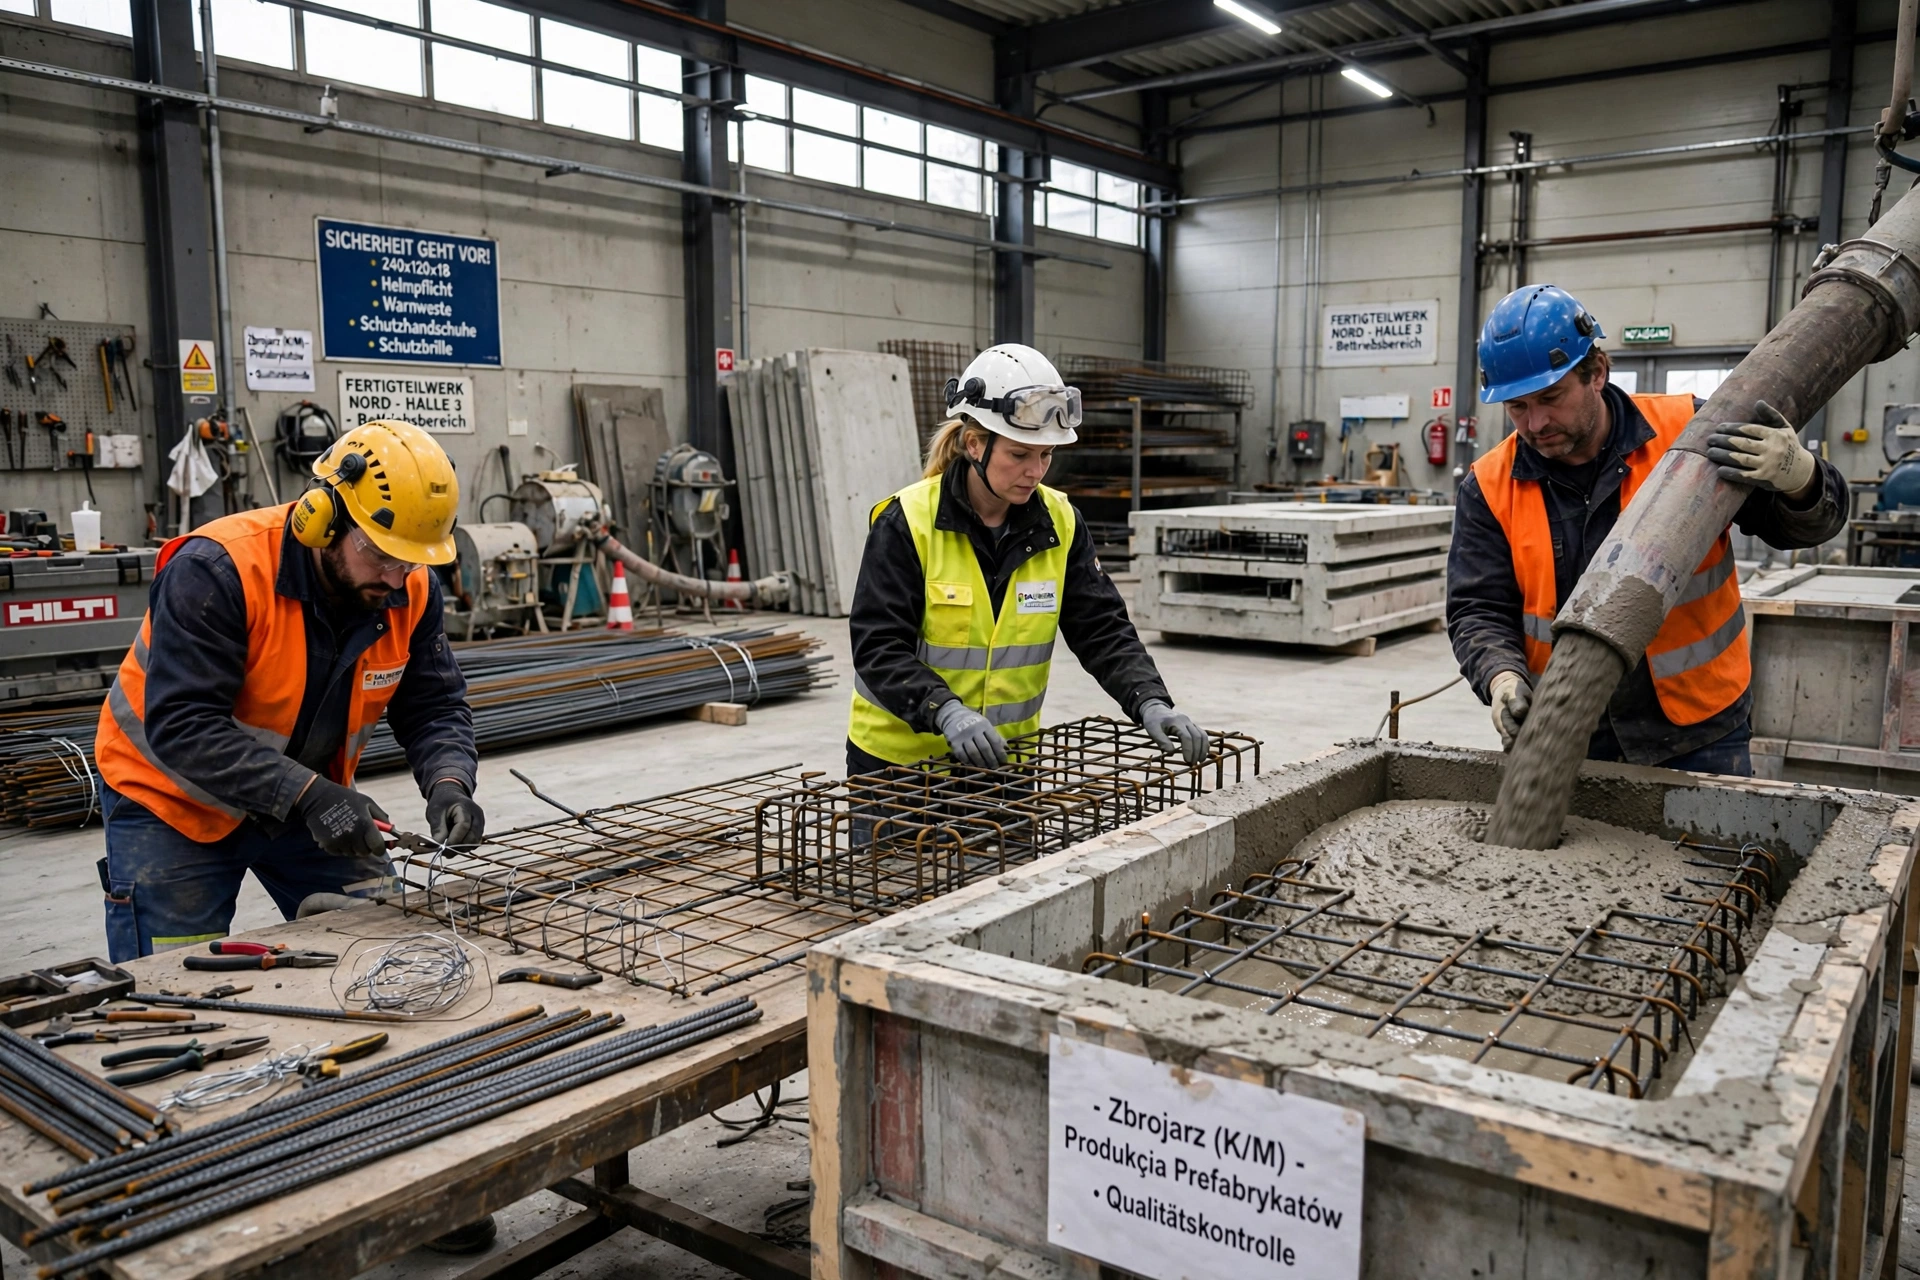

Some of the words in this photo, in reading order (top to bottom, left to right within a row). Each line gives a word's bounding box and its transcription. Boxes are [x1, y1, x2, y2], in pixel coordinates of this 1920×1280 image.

[325, 229, 414, 256] SICHERHEIT
[417, 240, 456, 259] GEHT
[458, 245, 491, 265] VOR!
[381, 257, 451, 278] 240x120x18
[381, 276, 453, 298] Helmpflicht
[382, 296, 452, 317] Warnweste
[360, 315, 477, 338] Schutzhandschuhe
[1331, 310, 1428, 326] FERTIGTEILWERK
[1332, 327, 1364, 339] NORD
[1375, 324, 1411, 337] HALLE
[1415, 324, 1422, 335] 3
[379, 337, 453, 356] Schutzbrille
[346, 378, 464, 395] FERTIGTEILWERK
[349, 396, 391, 409] NORD
[406, 397, 449, 411] HALLE
[454, 399, 462, 411] 3
[9, 598, 114, 624] HILTI
[1109, 1097, 1206, 1148] Zbrojarz
[1214, 1126, 1286, 1177] (K/M)
[1065, 1125, 1167, 1178] Produkçia
[1175, 1158, 1343, 1229] Prefabrykatów
[1106, 1185, 1296, 1266] Qualitätskontrolle
